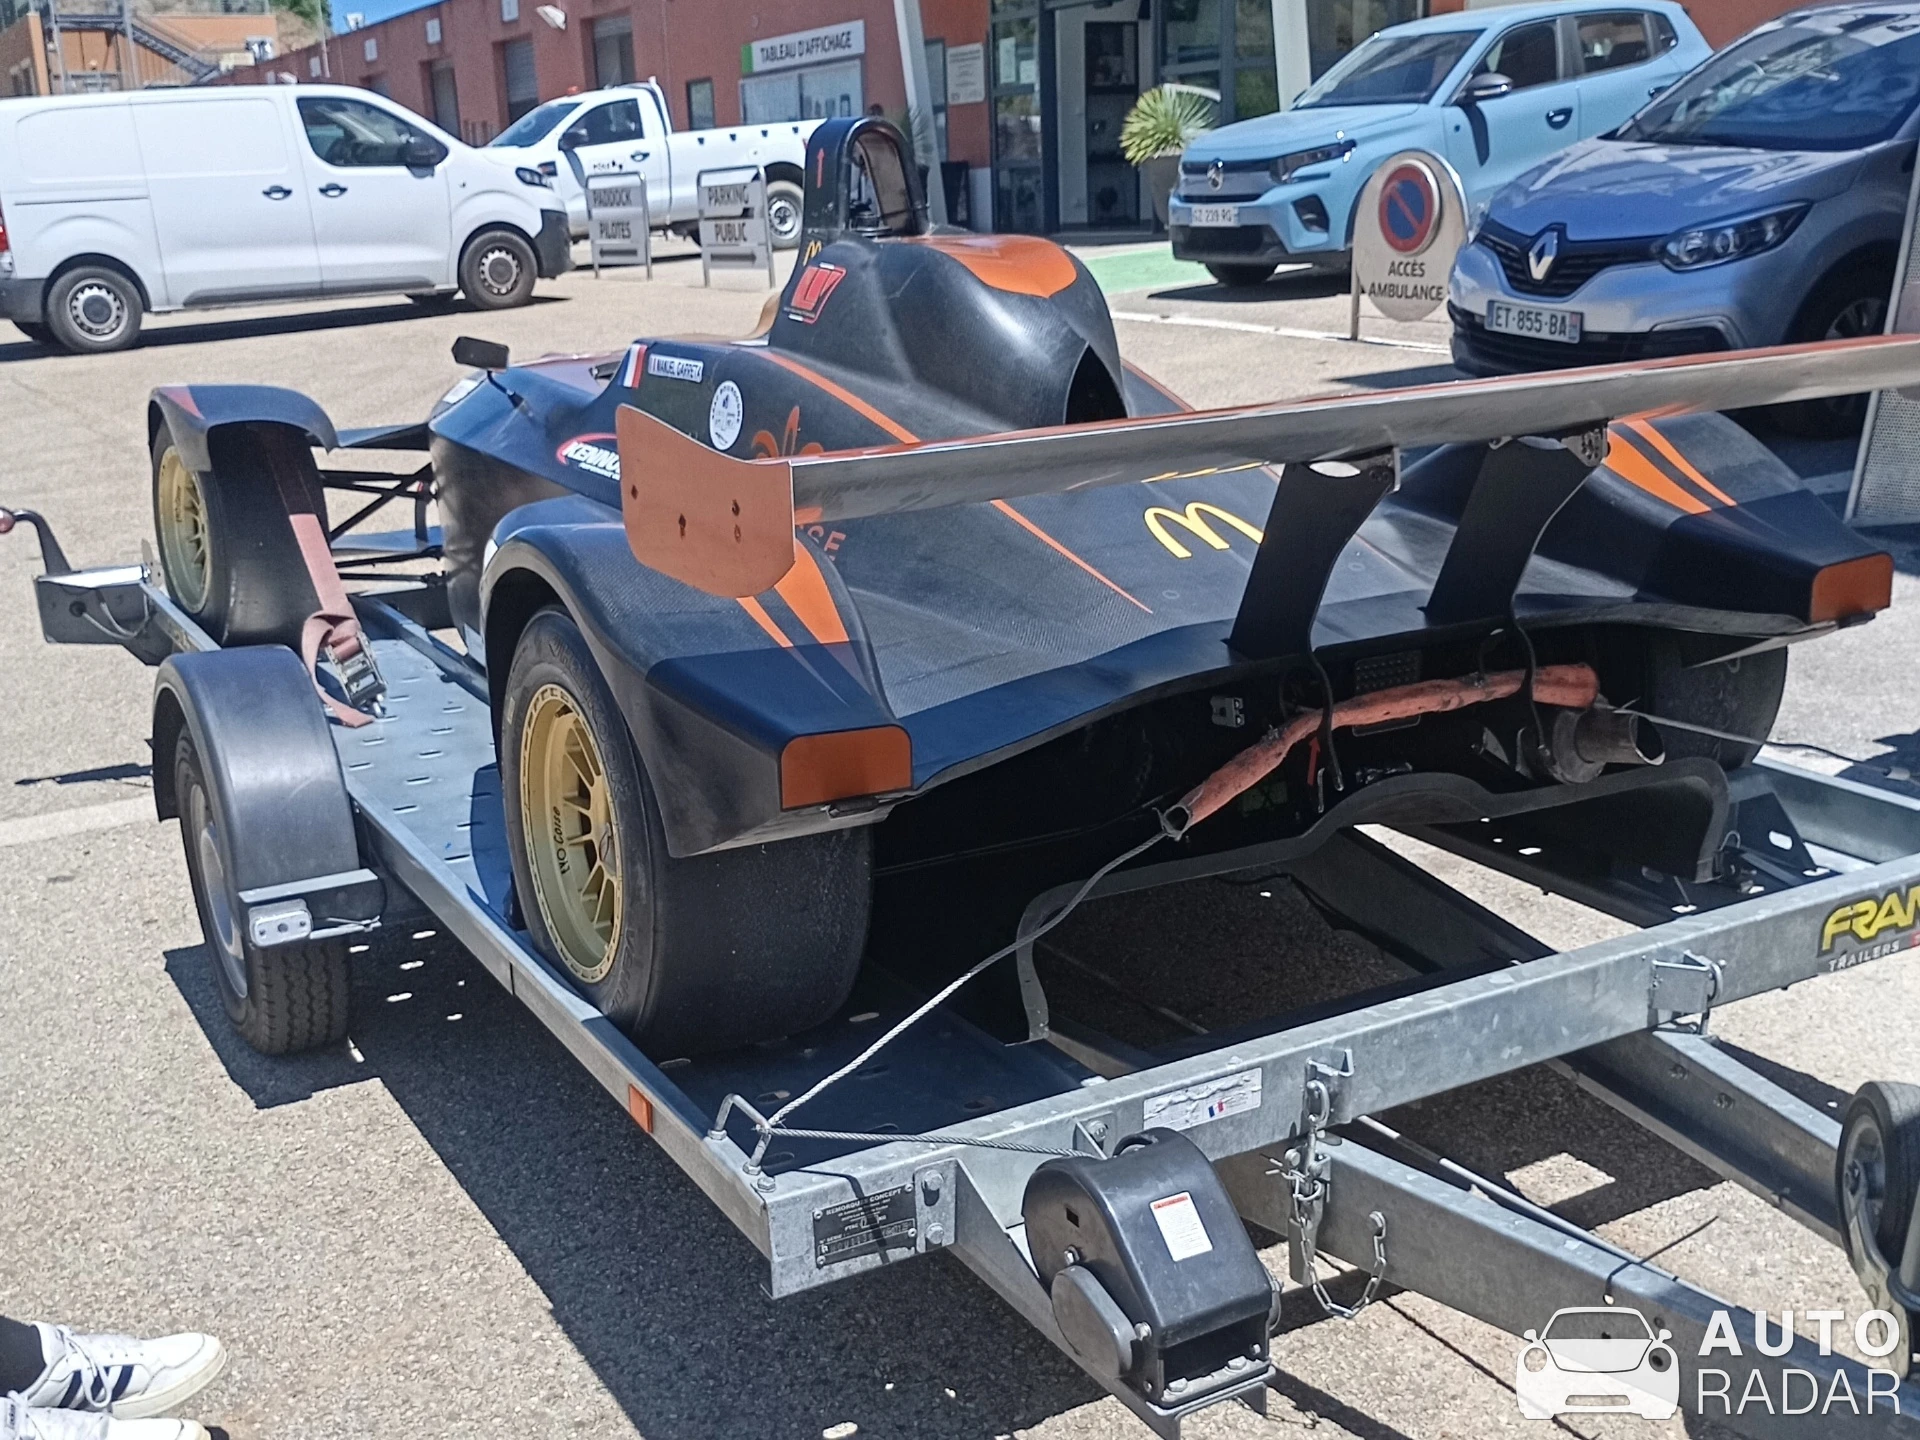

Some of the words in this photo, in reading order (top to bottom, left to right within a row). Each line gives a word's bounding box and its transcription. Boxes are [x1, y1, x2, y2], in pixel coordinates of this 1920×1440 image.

[760, 42, 797, 61] TABLEAU
[798, 31, 851, 57] D'AFFICHAGE
[593, 189, 632, 207] PADDOCK
[708, 185, 750, 206] PARKING
[600, 221, 632, 240] PILOTES
[715, 223, 748, 242] PUBLIC
[1388, 261, 1425, 278] ACCÈS
[1368, 282, 1444, 301] AMBULANCE
[1829, 940, 1899, 972] TRAILERS
[869, 1188, 902, 1203] CONCEPT
